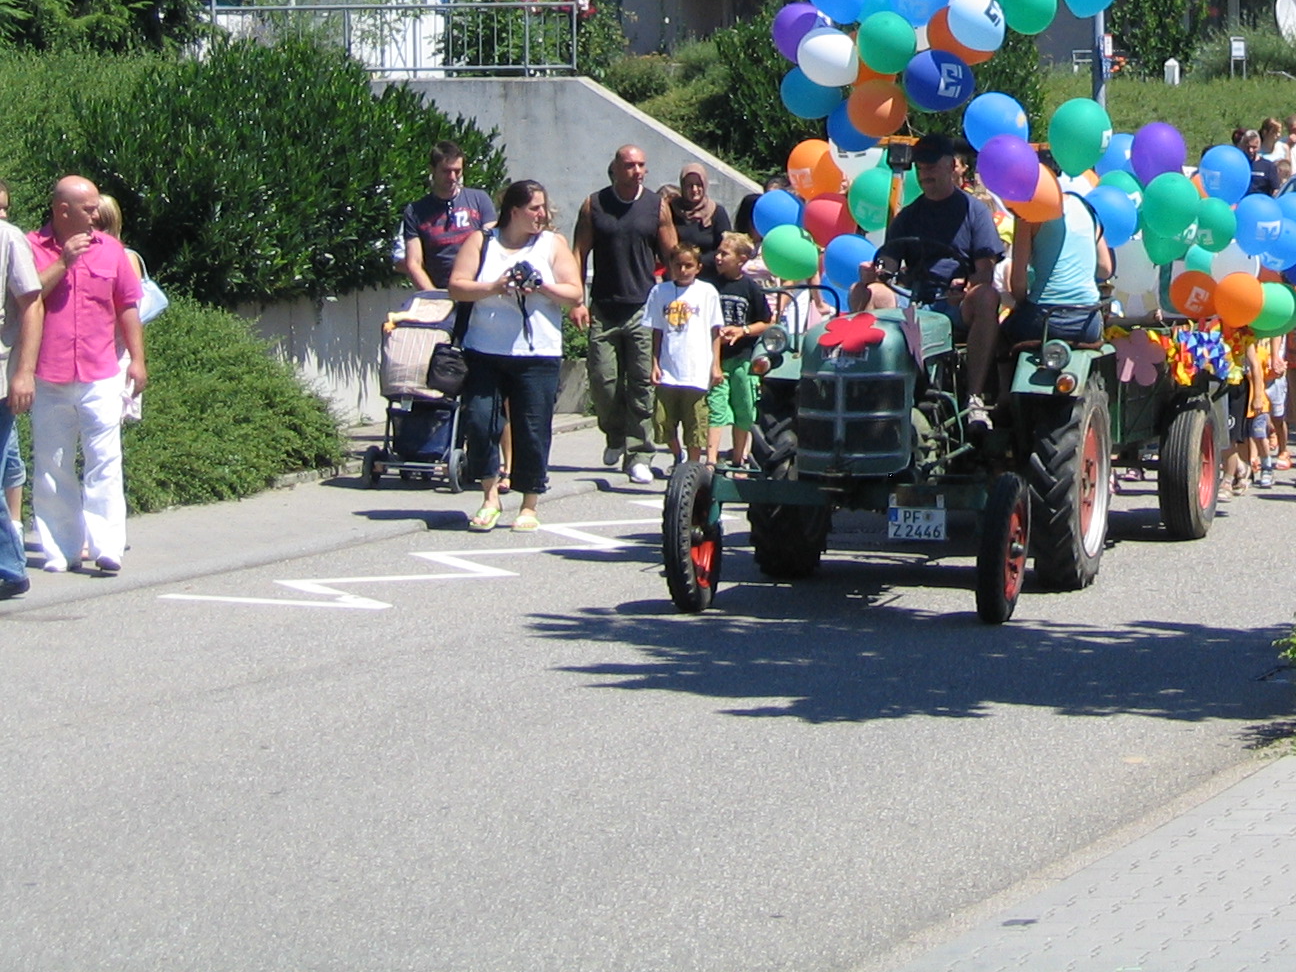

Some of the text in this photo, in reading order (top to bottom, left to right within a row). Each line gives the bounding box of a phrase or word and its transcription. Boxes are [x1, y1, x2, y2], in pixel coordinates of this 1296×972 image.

[903, 510, 922, 523] PF
[893, 524, 942, 539] Z 2446
